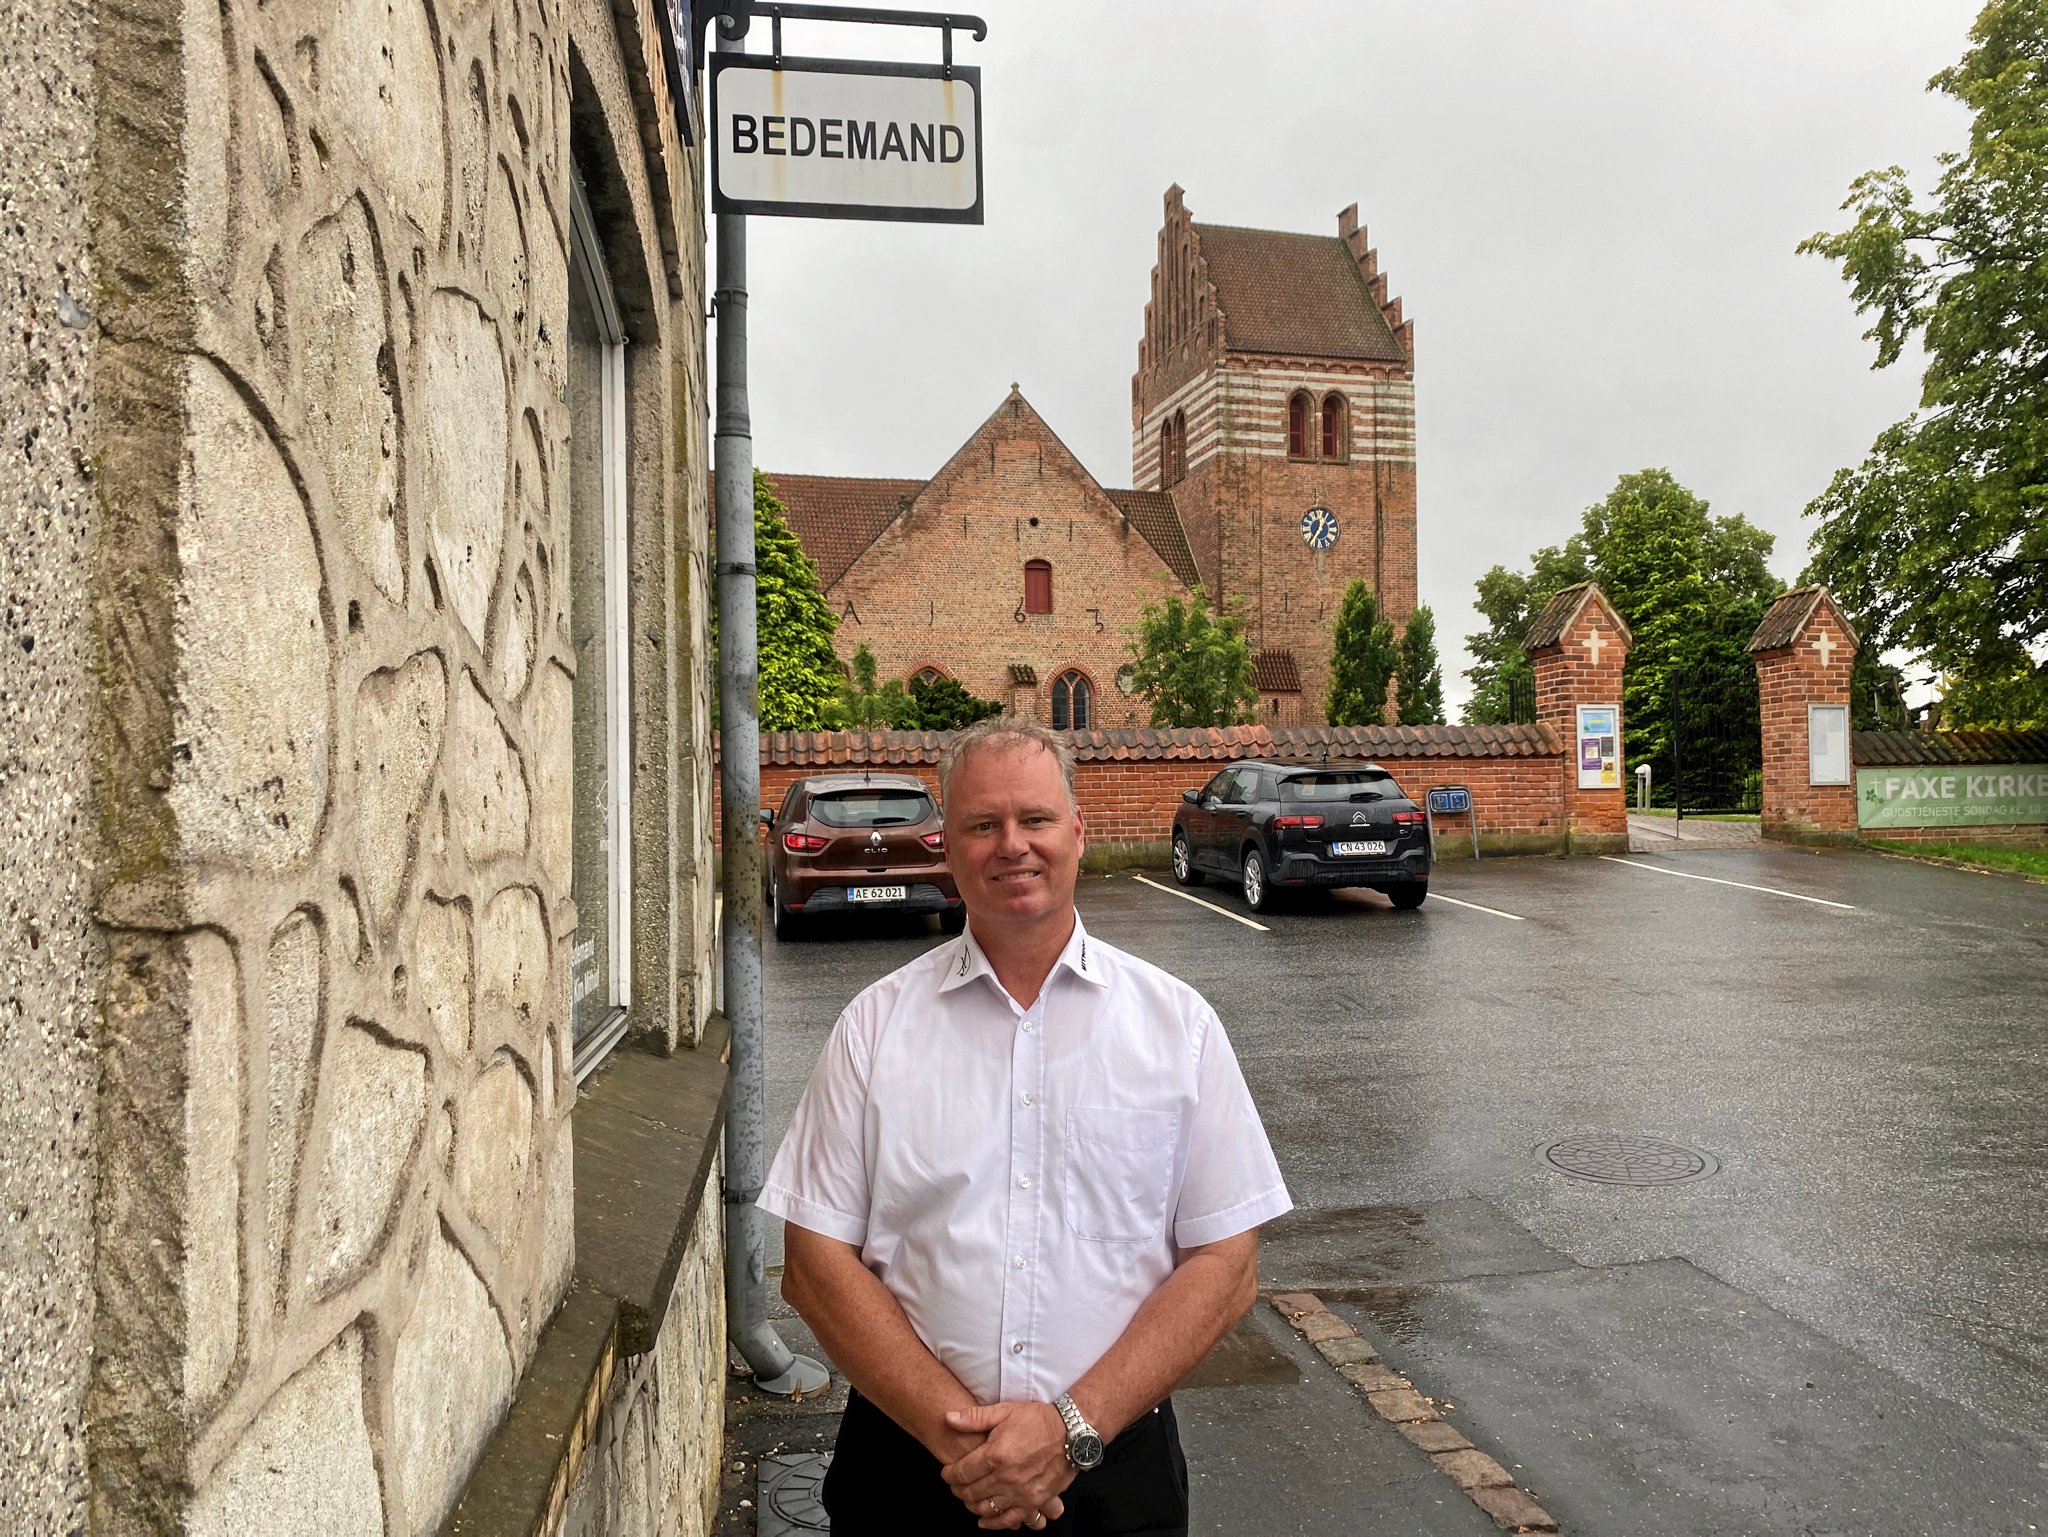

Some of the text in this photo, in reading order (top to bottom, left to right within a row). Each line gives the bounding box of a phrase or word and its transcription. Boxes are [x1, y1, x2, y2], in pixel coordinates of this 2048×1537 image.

[732, 114, 965, 163] BEDEMAND
[1885, 775, 2048, 800] FAXE KIRKE
[1882, 806, 1960, 818] GUDSTJENESTE
[1963, 804, 2007, 816] SØNDAG
[1340, 841, 1384, 852] CN 43 026
[855, 887, 903, 899] AE 62 021
